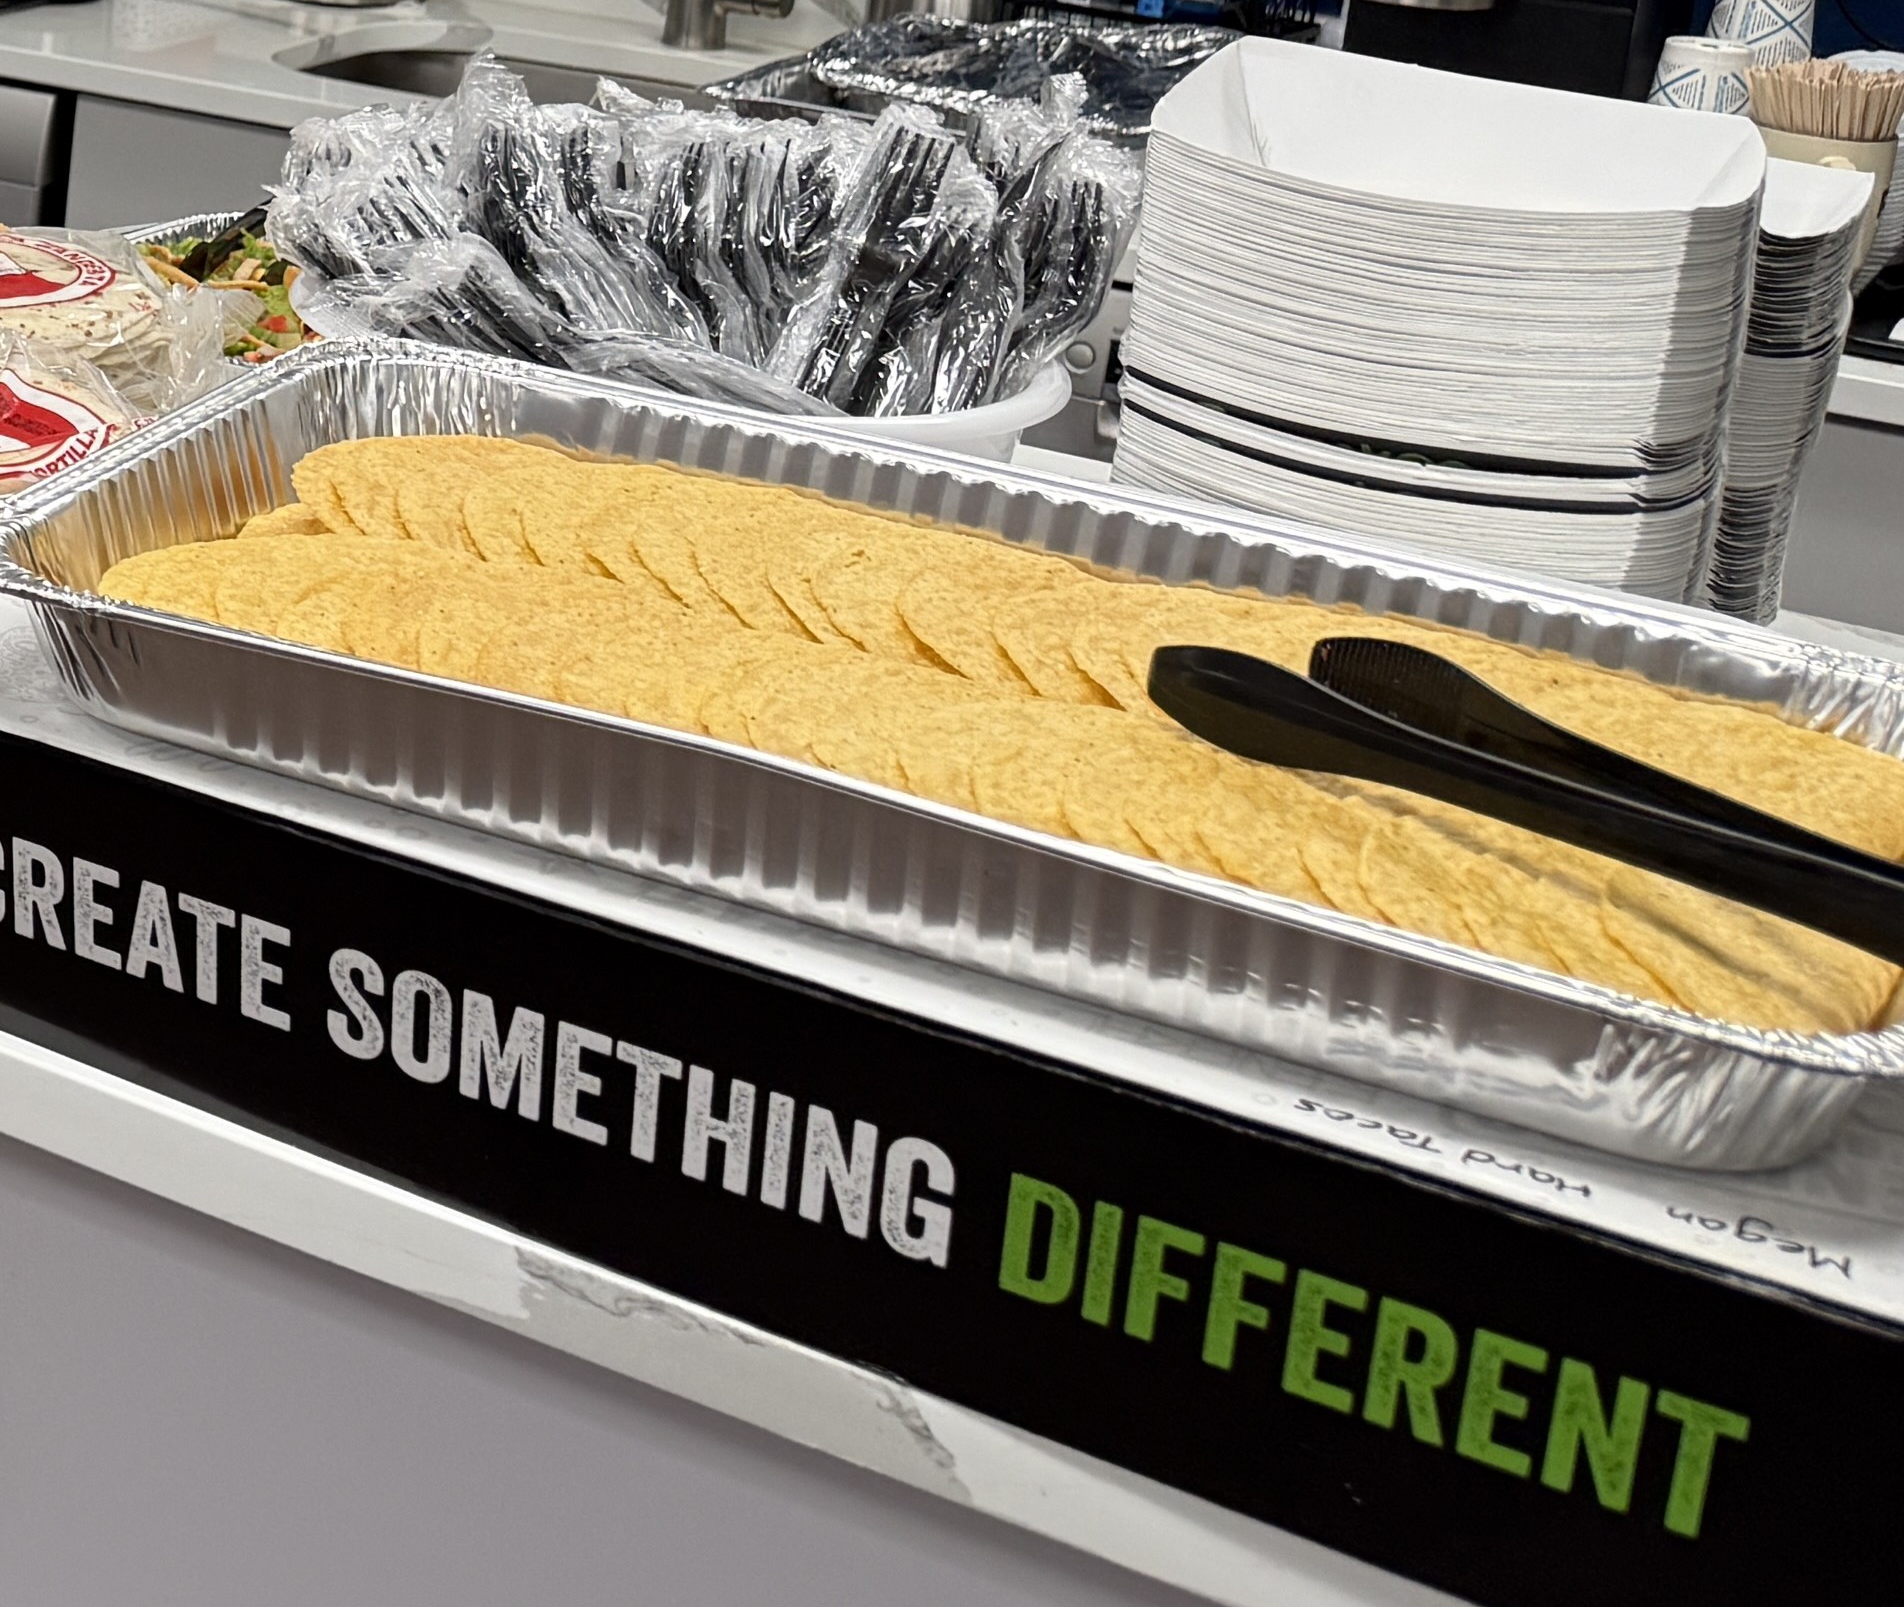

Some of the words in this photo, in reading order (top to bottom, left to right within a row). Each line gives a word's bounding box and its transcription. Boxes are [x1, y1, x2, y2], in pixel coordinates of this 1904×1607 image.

[1293, 1096, 1442, 1155] Tacos
[1461, 1147, 1592, 1197] Hard
[324, 942, 960, 1274] SOMETHING
[995, 1169, 1754, 1542] DIFFERENT
[1666, 1204, 1853, 1280] Megan
